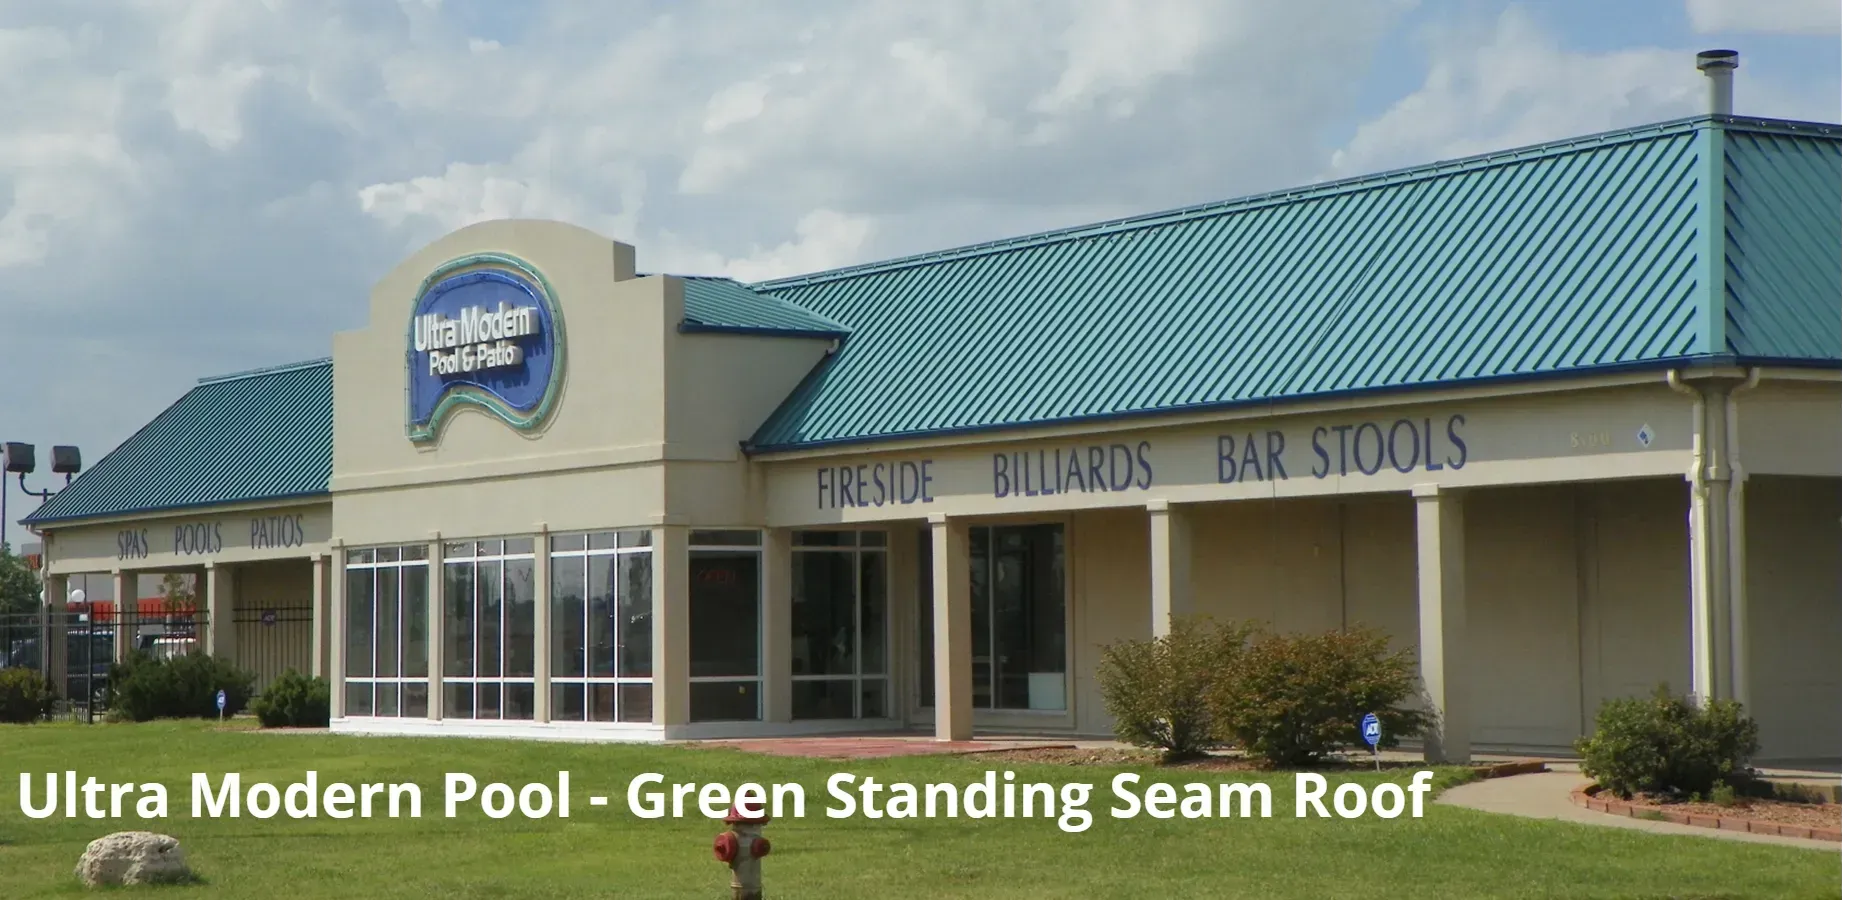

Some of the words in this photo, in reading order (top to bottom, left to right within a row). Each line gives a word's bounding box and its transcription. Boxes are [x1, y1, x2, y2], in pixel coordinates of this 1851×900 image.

[414, 313, 457, 352] Ultra
[461, 302, 533, 346] Modern
[430, 348, 459, 376] Pool
[462, 345, 476, 372] &
[477, 342, 514, 369] Patio
[817, 460, 934, 509] FIRESIDE
[993, 441, 1153, 499] BILLIARDS
[1217, 430, 1288, 484] BAR
[1312, 414, 1467, 480] STOOLS
[117, 528, 148, 561] SPAS
[174, 521, 222, 556] POOLS
[251, 514, 304, 549] PATIOS
